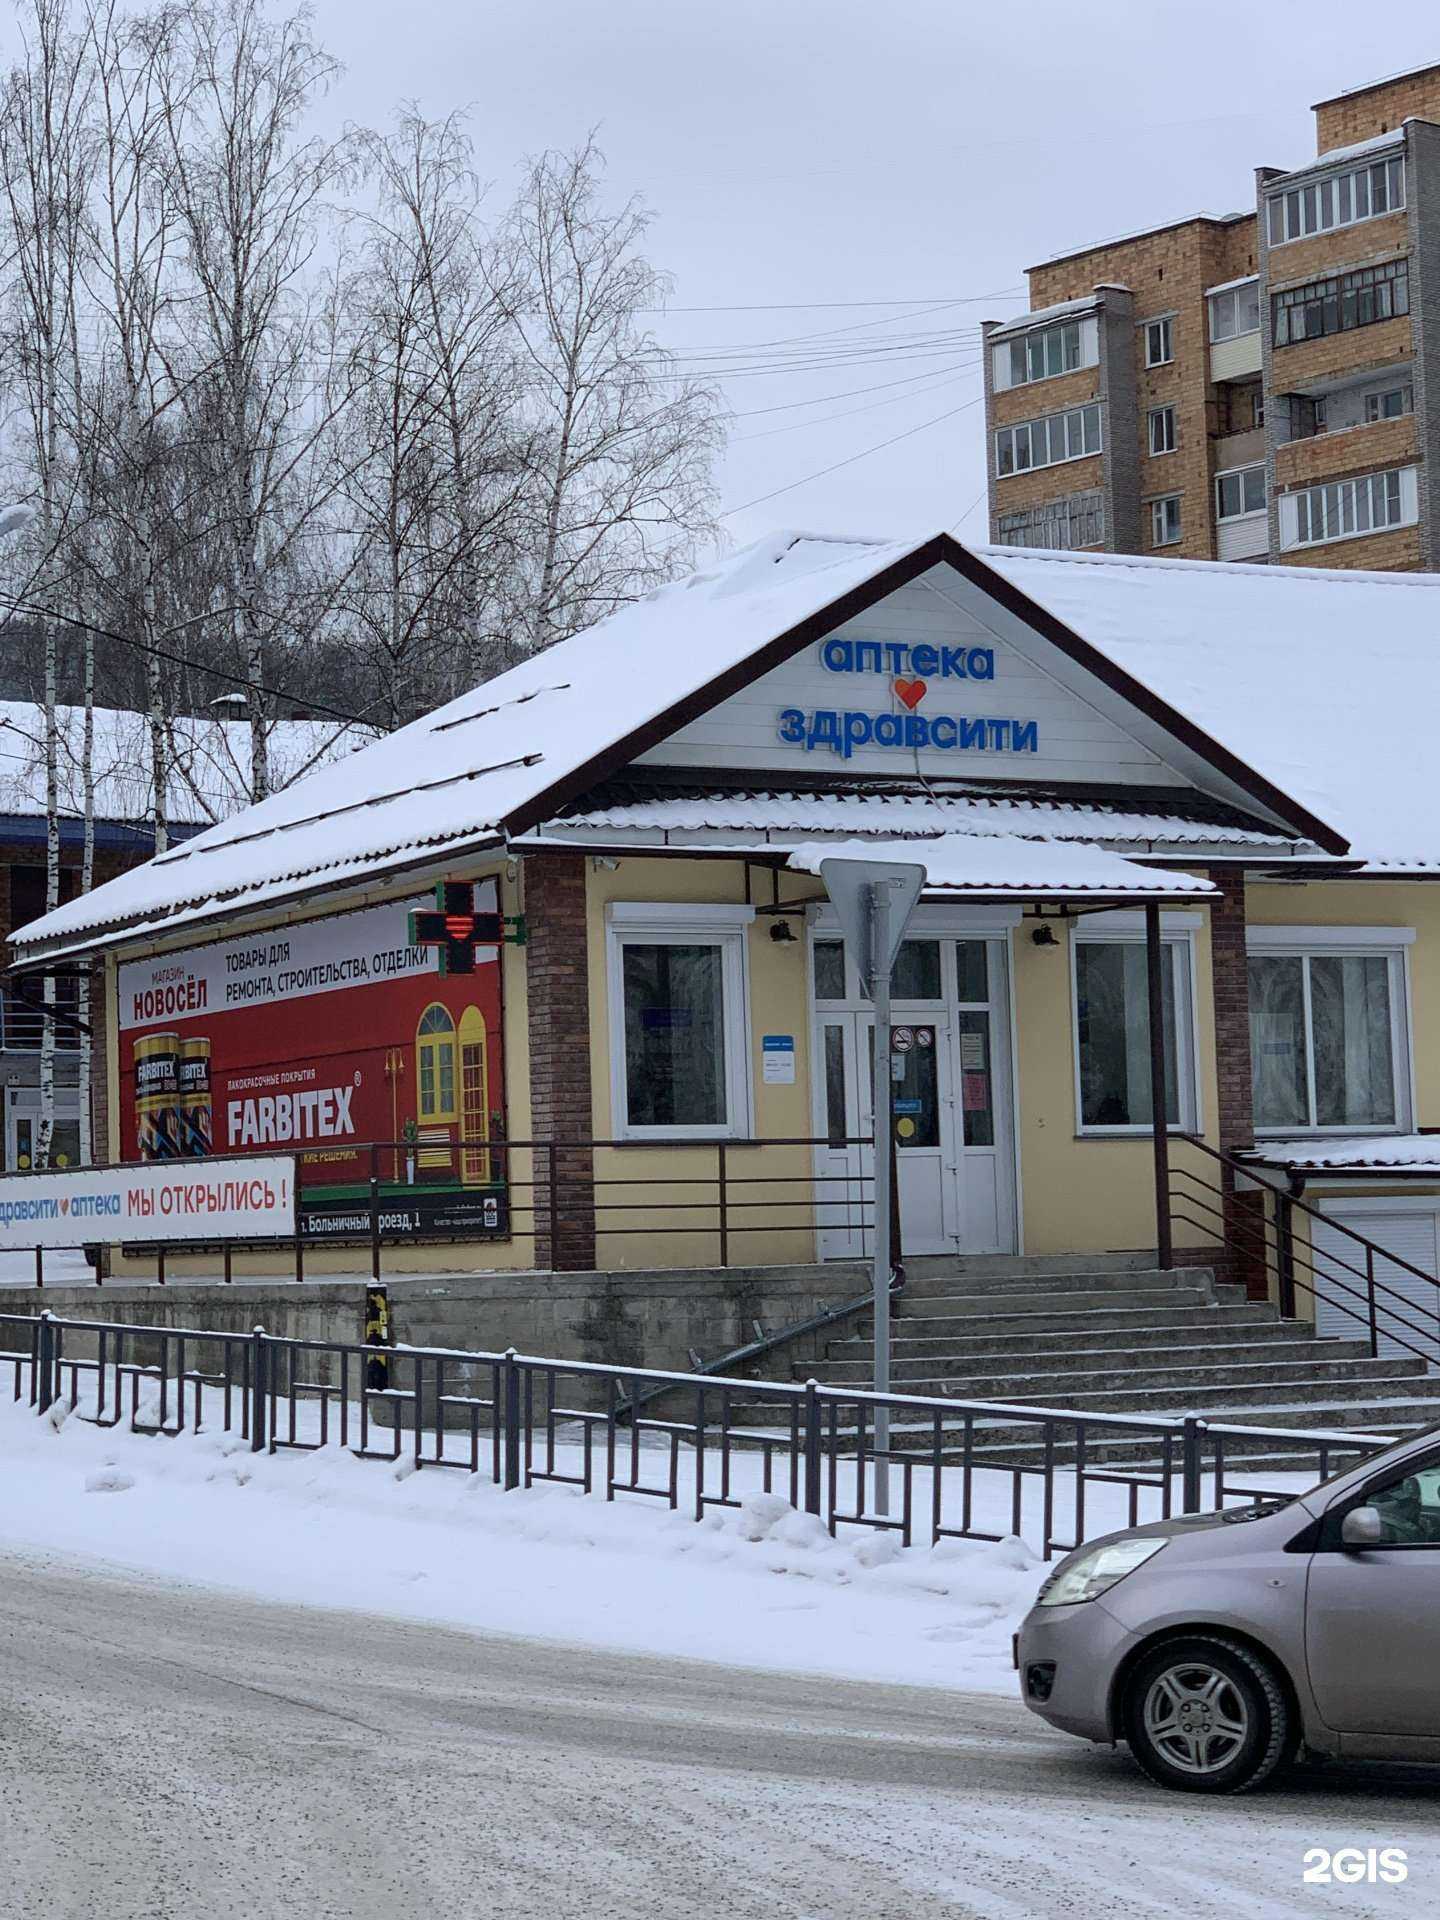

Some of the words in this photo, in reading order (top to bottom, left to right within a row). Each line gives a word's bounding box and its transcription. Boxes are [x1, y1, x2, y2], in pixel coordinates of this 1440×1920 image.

[822, 639, 995, 680] аптека
[779, 709, 1038, 758] здравсити
[151, 966, 185, 985] МАГАЗИН
[225, 949, 267, 973] ТОВАРЫ
[268, 942, 290, 968] ДЛЯ
[226, 976, 276, 1002] РЕМОНТА,
[277, 957, 370, 992] СТРОИТЕЛЬСТВА,
[372, 944, 429, 976] ОТДЕЛКИ
[133, 974, 208, 1020] НОВОСЁЛ
[137, 1060, 175, 1083] FARBITEX
[227, 1073, 280, 1091] ЛАКОКРАСОЧНЫЕ
[281, 1068, 316, 1084] ПОКРЫТИЯ
[0, 1198, 59, 1229] дравсити
[70, 1193, 121, 1217] аптека
[127, 1188, 154, 1217] МЫ
[160, 1179, 275, 1216] ОТКРЫЛИСЬ
[308, 1213, 370, 1233] Больничный
[376, 1213, 413, 1233] роезд,
